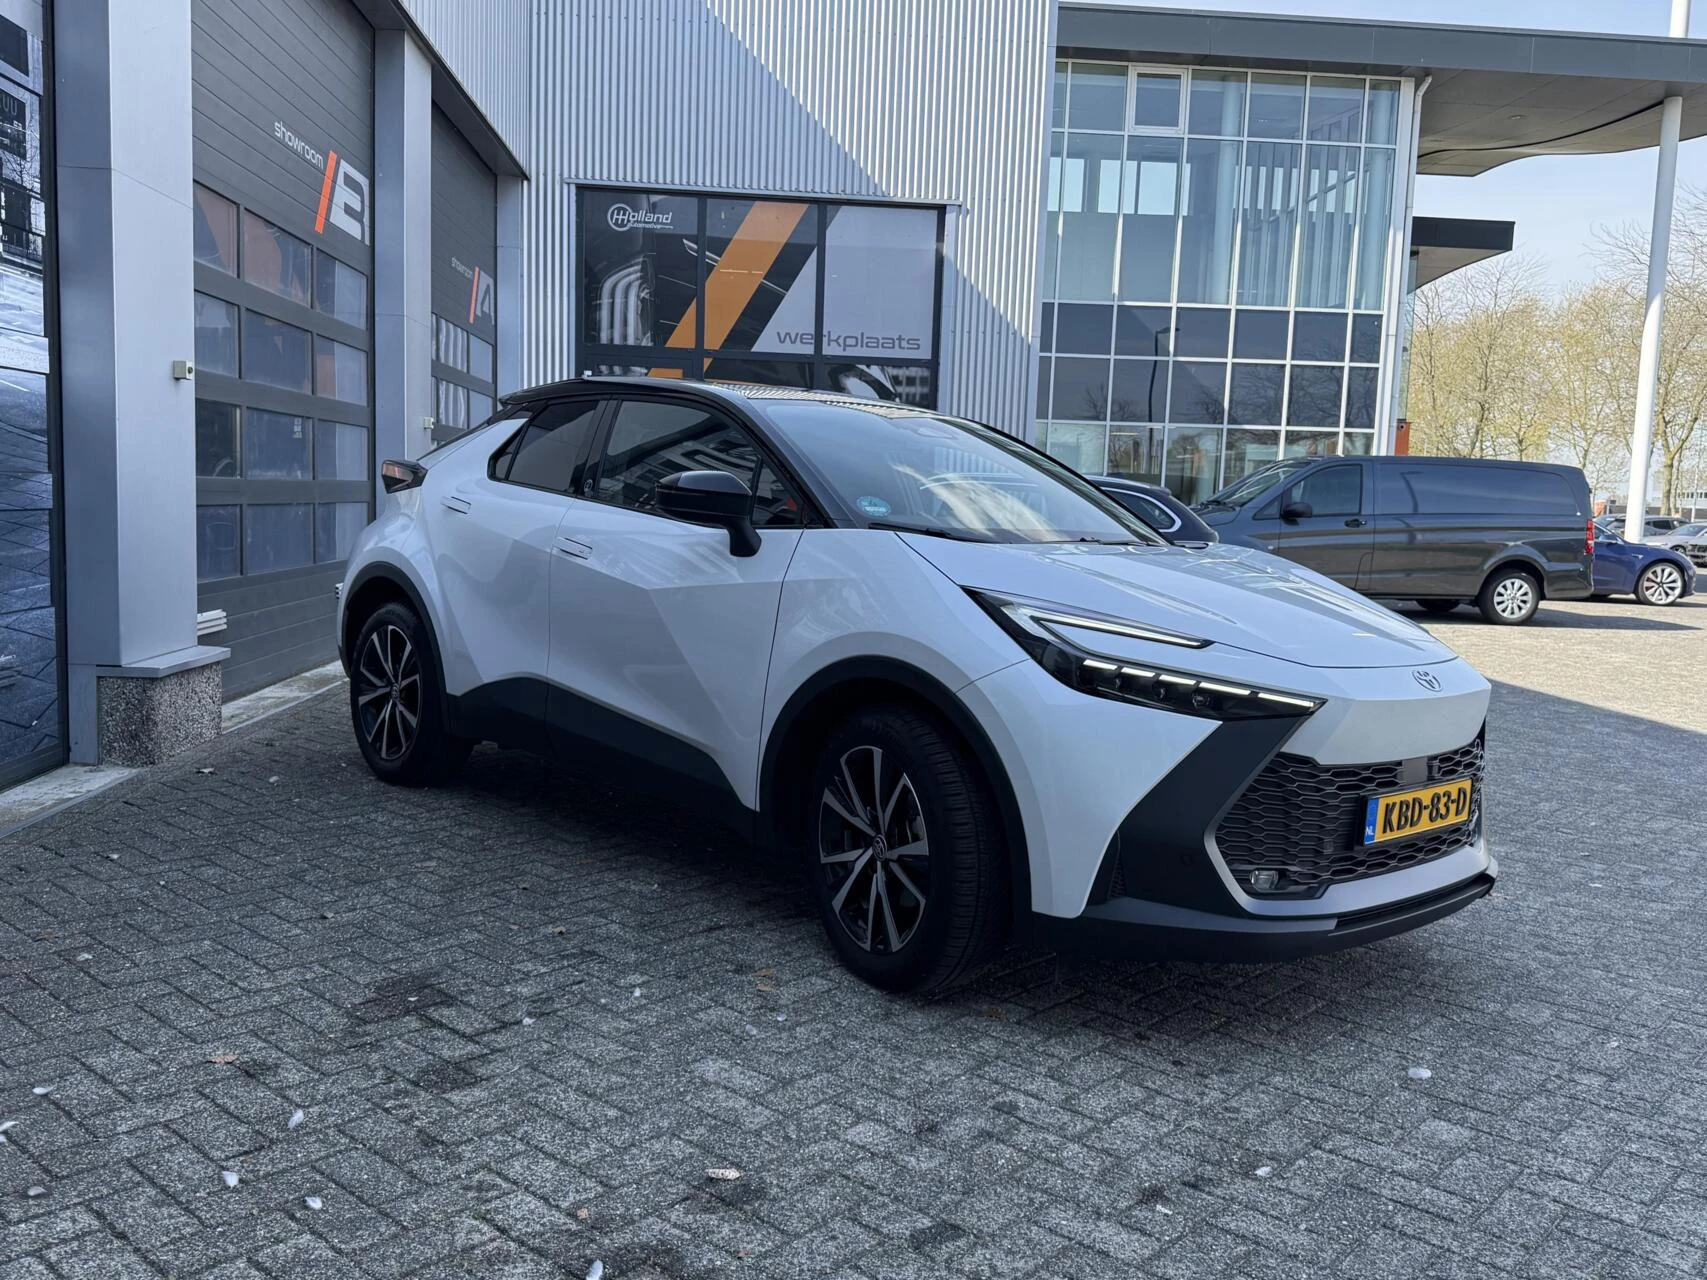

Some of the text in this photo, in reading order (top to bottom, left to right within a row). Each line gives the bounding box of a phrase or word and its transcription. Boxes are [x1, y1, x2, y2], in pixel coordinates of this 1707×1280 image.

[274, 120, 324, 170] showroom
[776, 330, 921, 352] wekplaats
[1364, 786, 1468, 836] NL KBD-83-D
